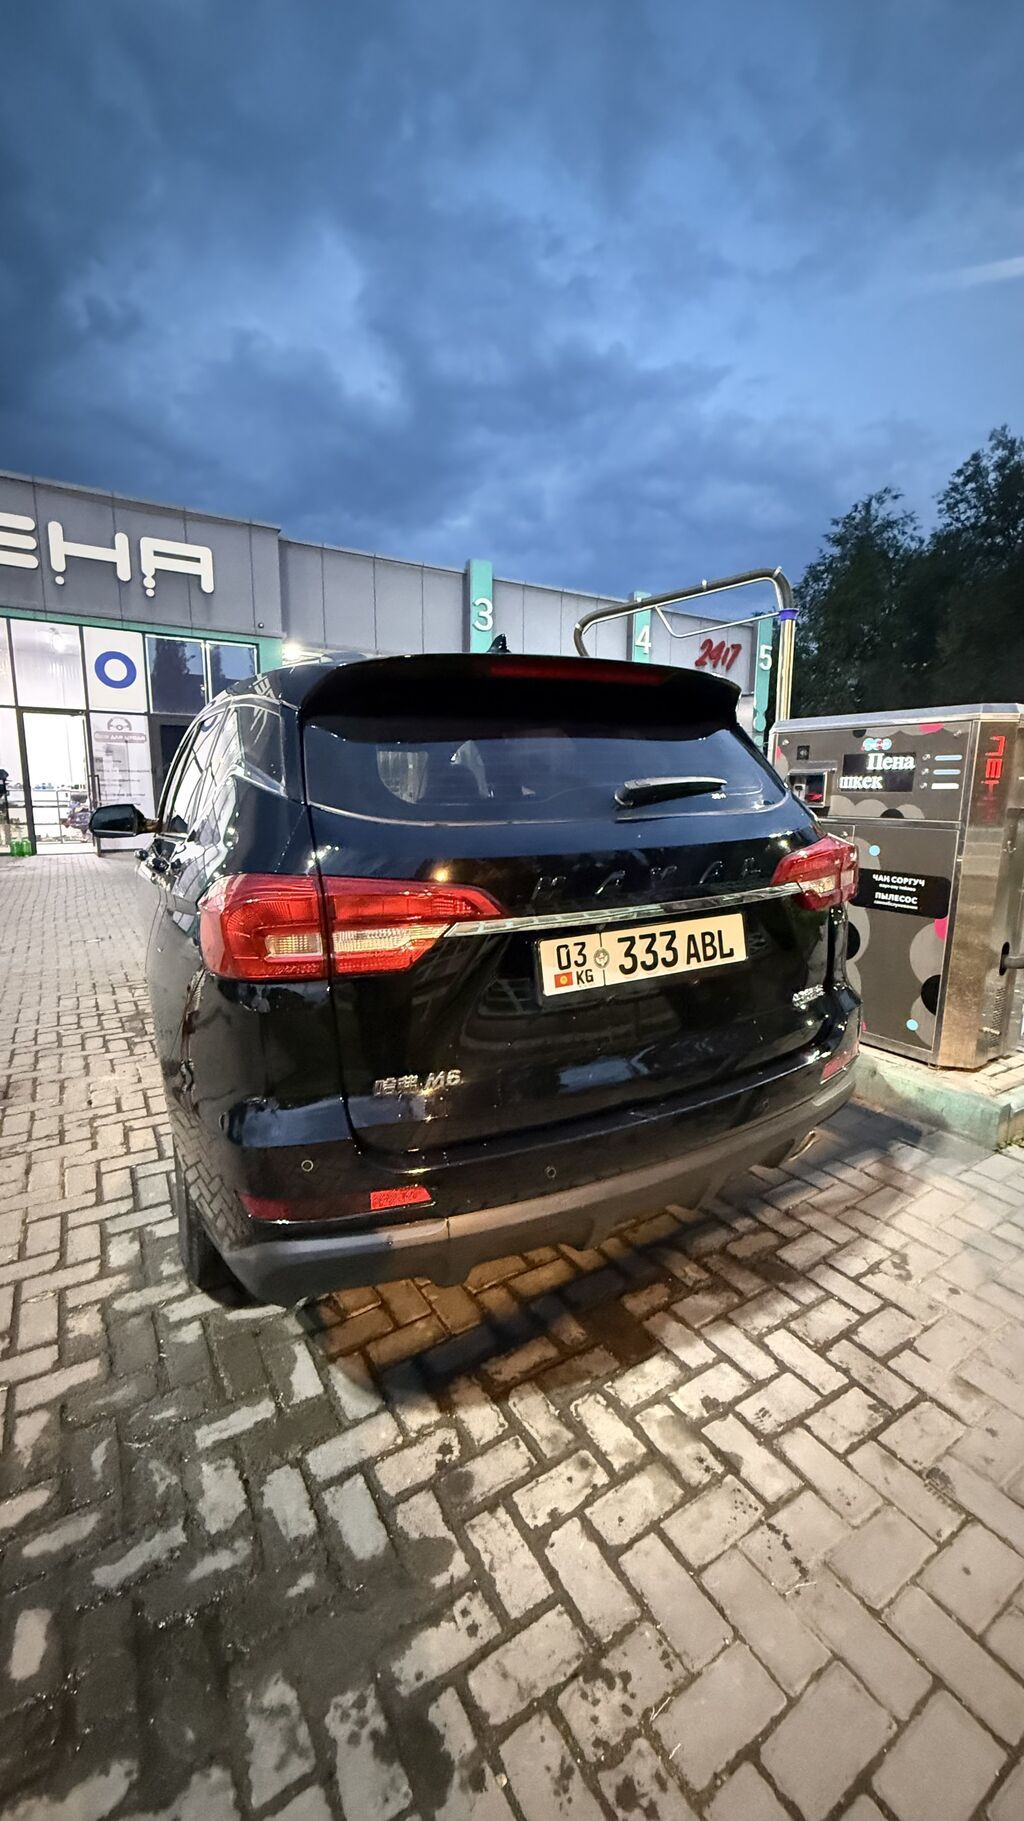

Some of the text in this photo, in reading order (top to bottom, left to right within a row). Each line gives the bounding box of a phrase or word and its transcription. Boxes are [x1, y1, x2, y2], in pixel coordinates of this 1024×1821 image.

[472, 598, 493, 632] 3
[635, 624, 651, 654] 4
[759, 645, 772, 671] 5
[866, 753, 916, 771] Пена
[872, 873, 890, 883] ЧАН
[890, 876, 926, 887] СОРГУЧ
[874, 891, 918, 905] ПЫЛЕСОС
[556, 942, 588, 970] 03
[617, 930, 735, 976] 333 ABL
[576, 969, 594, 985] KG
